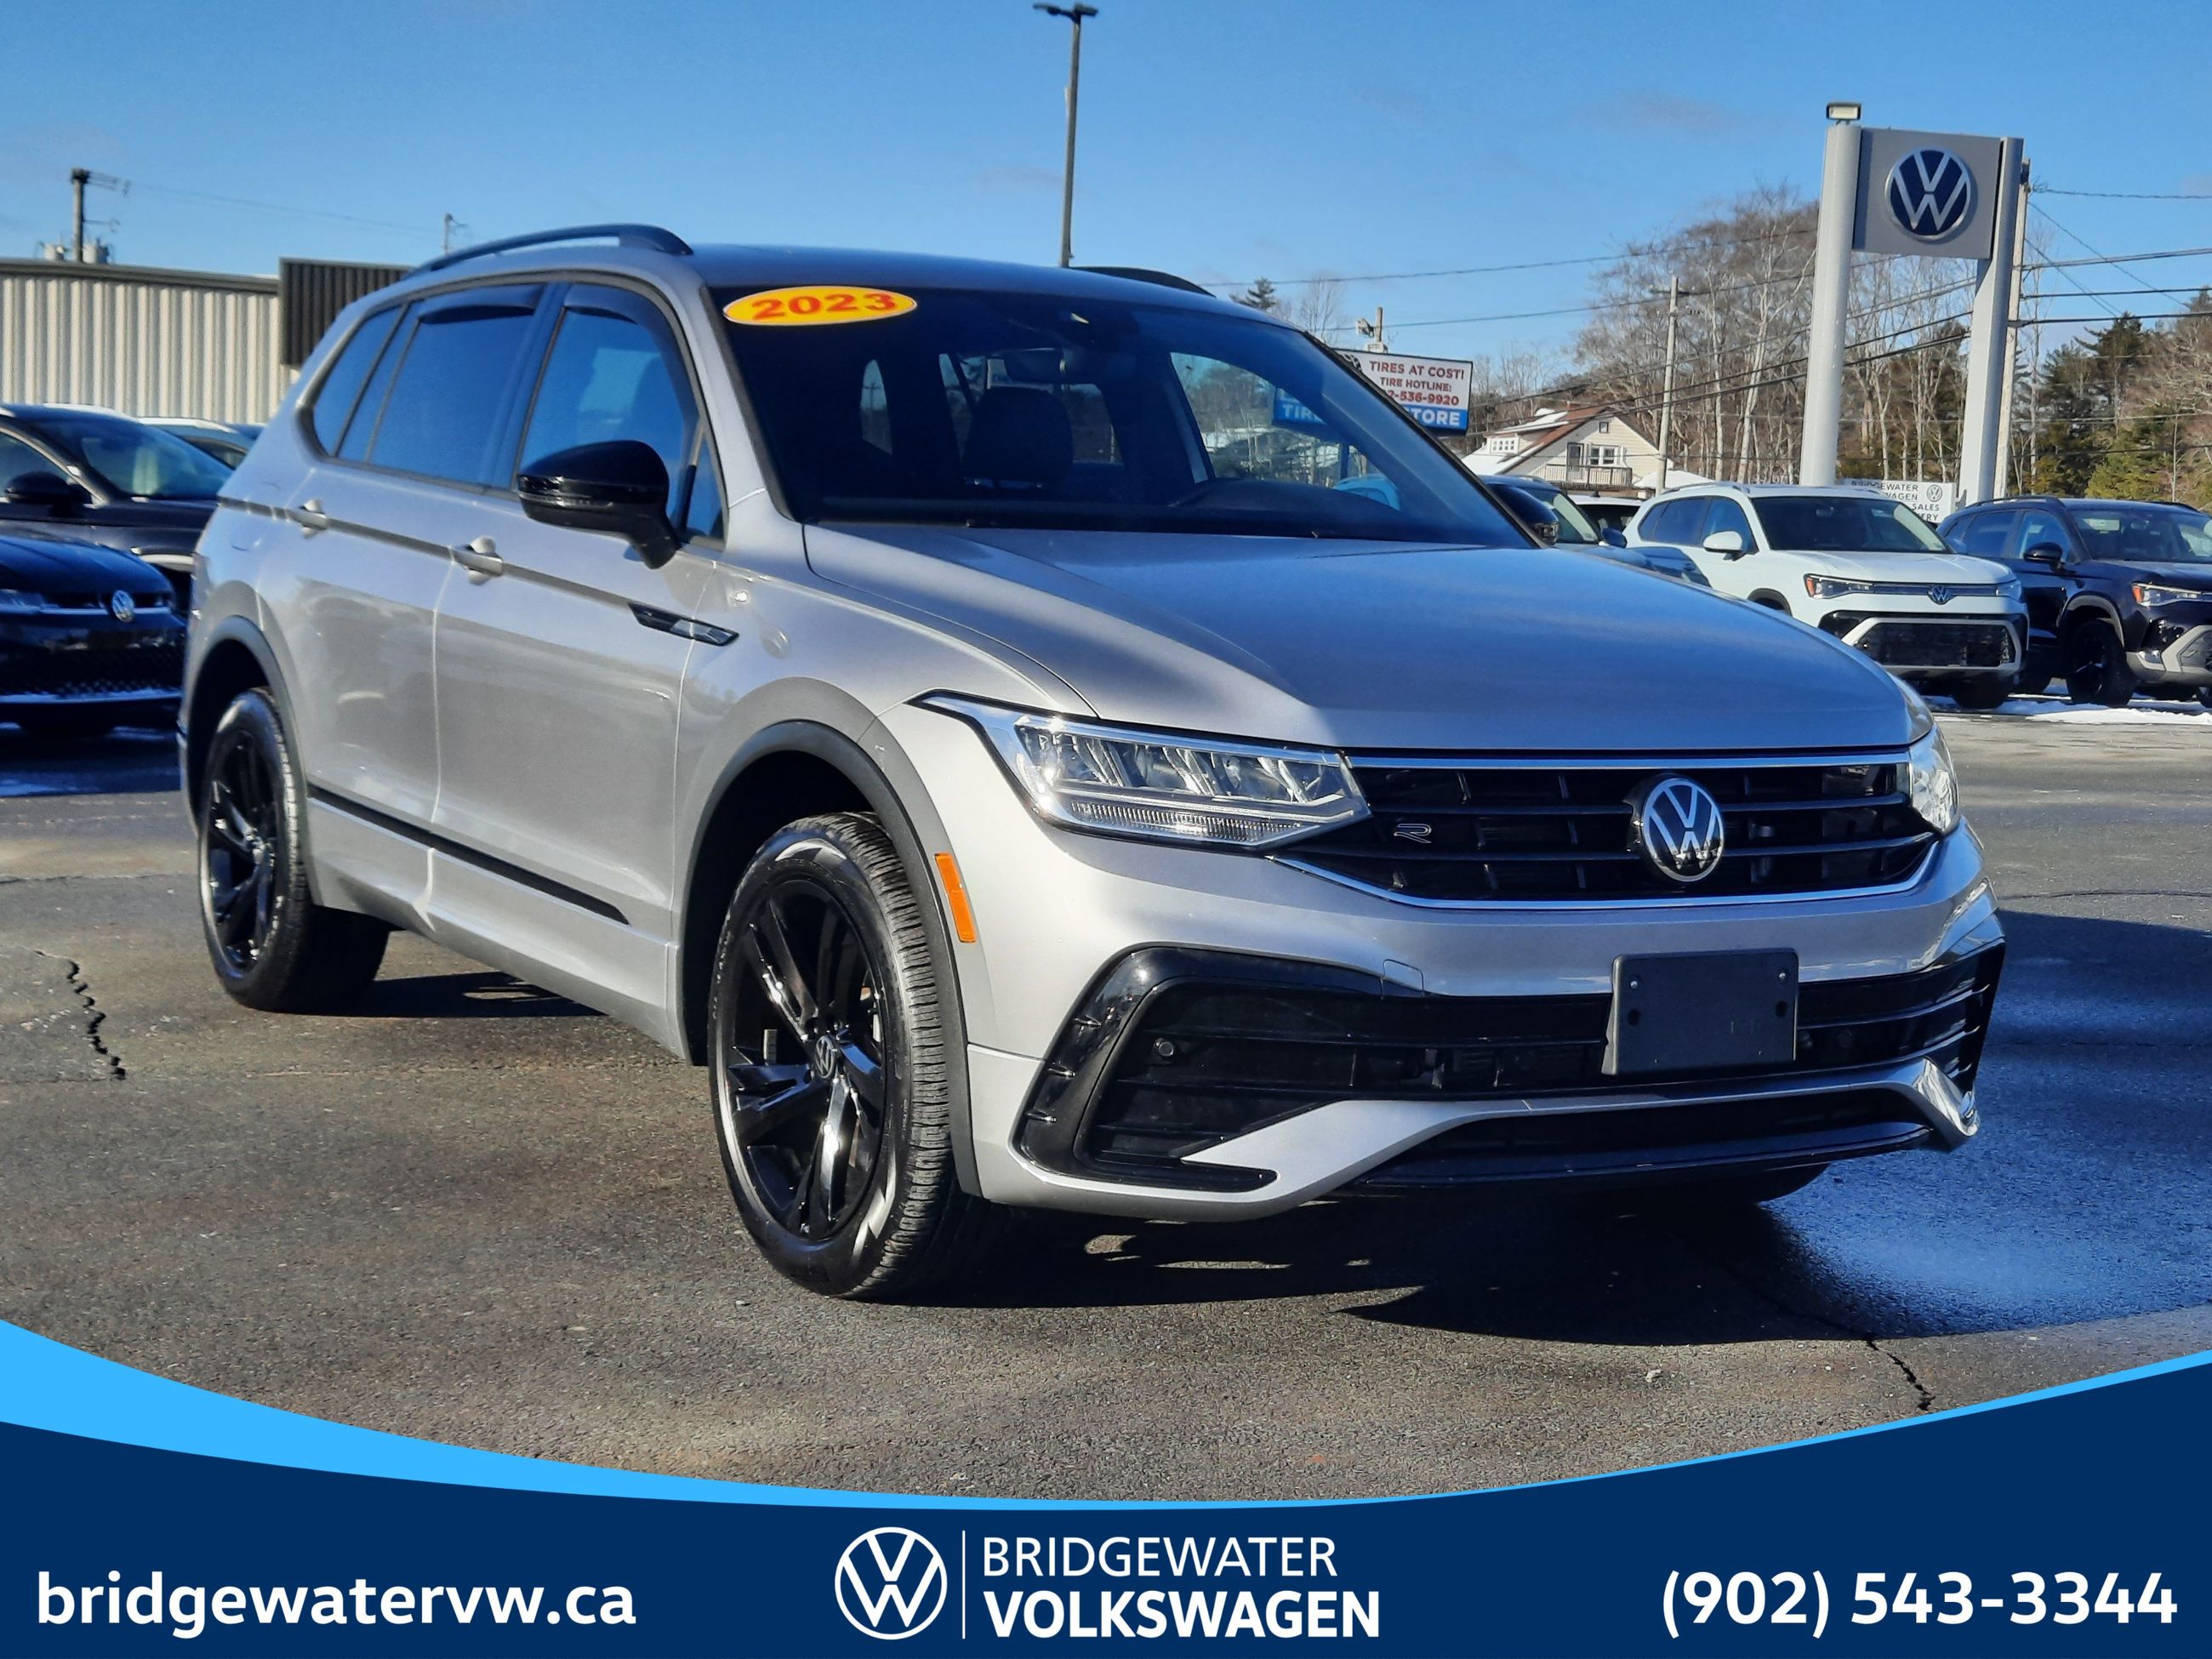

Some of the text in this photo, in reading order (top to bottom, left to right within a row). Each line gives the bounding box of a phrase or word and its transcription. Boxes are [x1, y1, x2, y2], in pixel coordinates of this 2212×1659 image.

[1889, 149, 1970, 235] VW
[751, 293, 898, 322] 2023
[1369, 361, 1464, 380] TIRES AT COST!
[1380, 377, 1452, 392] TIRE HOTLINE:
[1387, 390, 1459, 406] 2-536-9920
[1283, 404, 1461, 426] TIR TORE
[1912, 503, 1940, 511] SALES
[1645, 779, 1723, 876] VW
